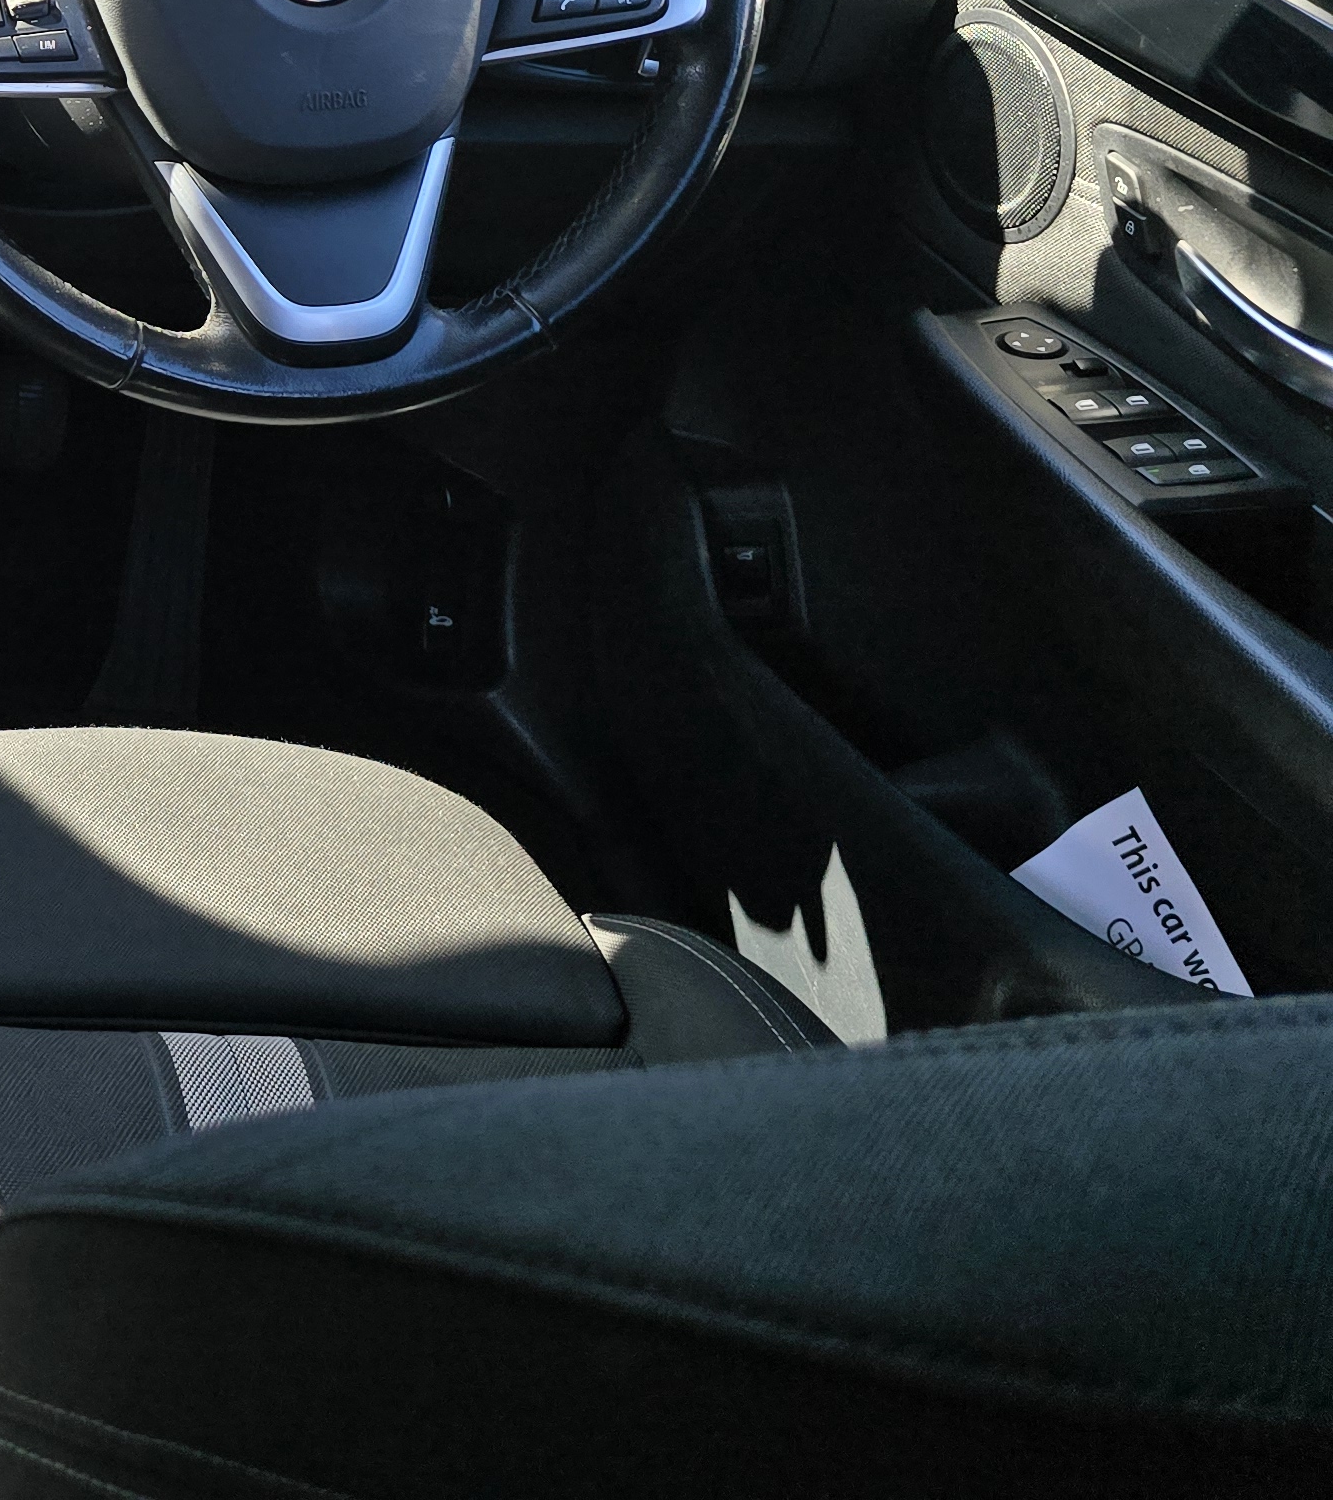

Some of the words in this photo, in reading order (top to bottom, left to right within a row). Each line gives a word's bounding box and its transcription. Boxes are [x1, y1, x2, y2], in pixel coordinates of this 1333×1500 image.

[301, 90, 369, 112] AIRBAG
[1111, 825, 1161, 894] This
[1152, 897, 1193, 945] car
